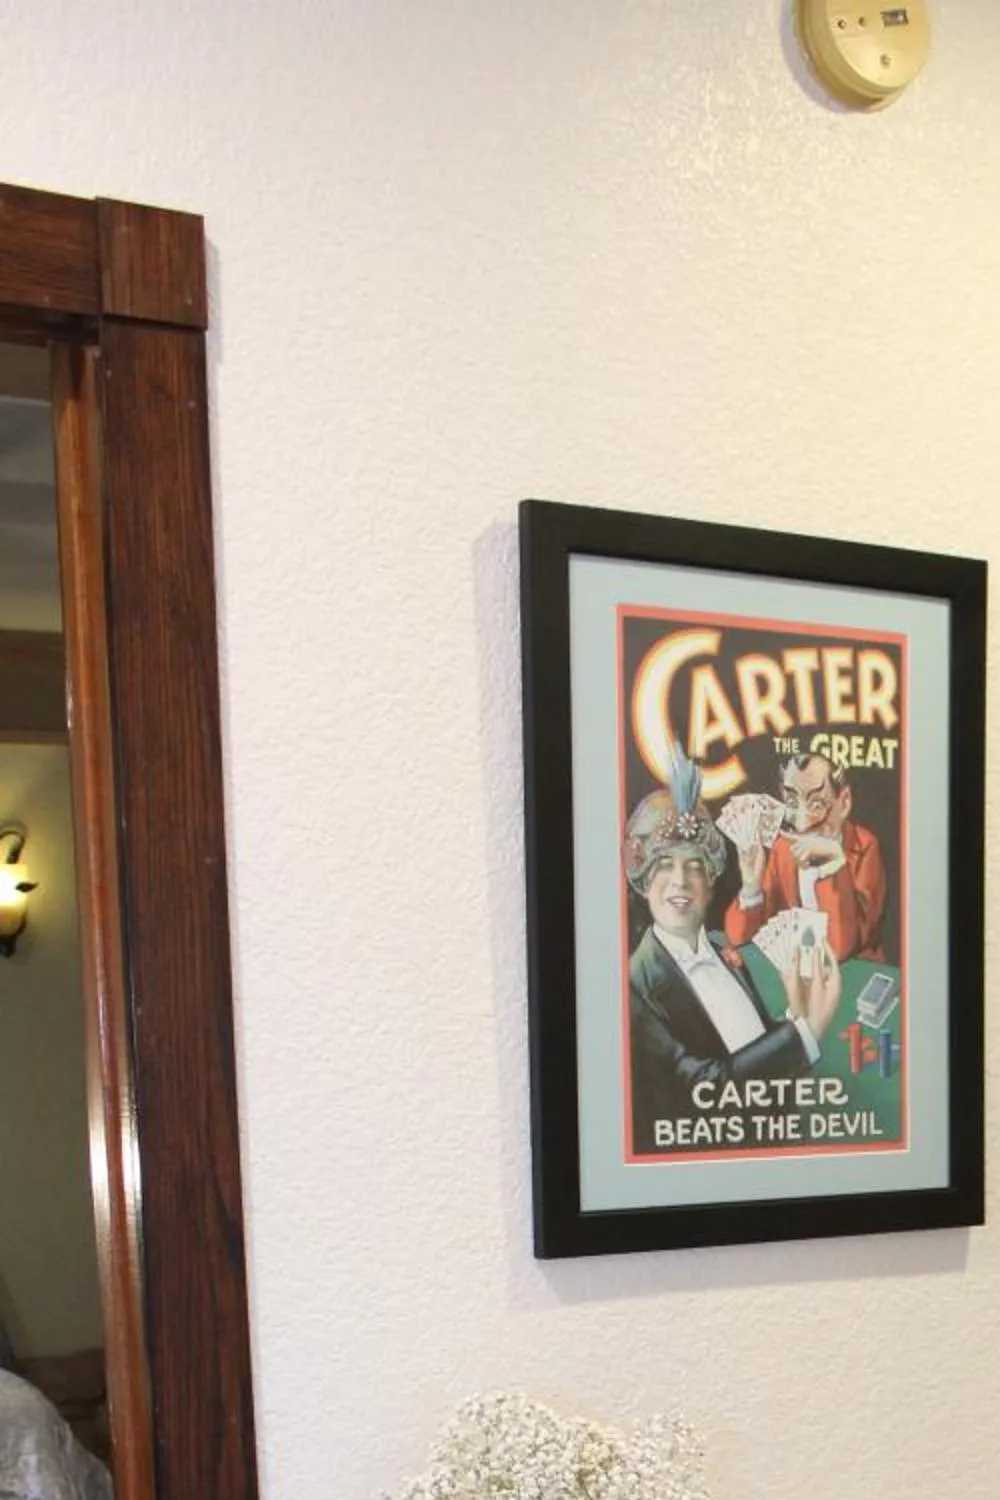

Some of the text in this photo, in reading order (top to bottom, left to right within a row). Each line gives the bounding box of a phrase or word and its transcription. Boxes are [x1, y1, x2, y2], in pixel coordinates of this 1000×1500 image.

[631, 626, 900, 800] CARTER
[773, 733, 899, 772] THE GREAT
[691, 1077, 849, 1110] CARTER
[653, 1110, 884, 1147] BEATS THE DEVIL
